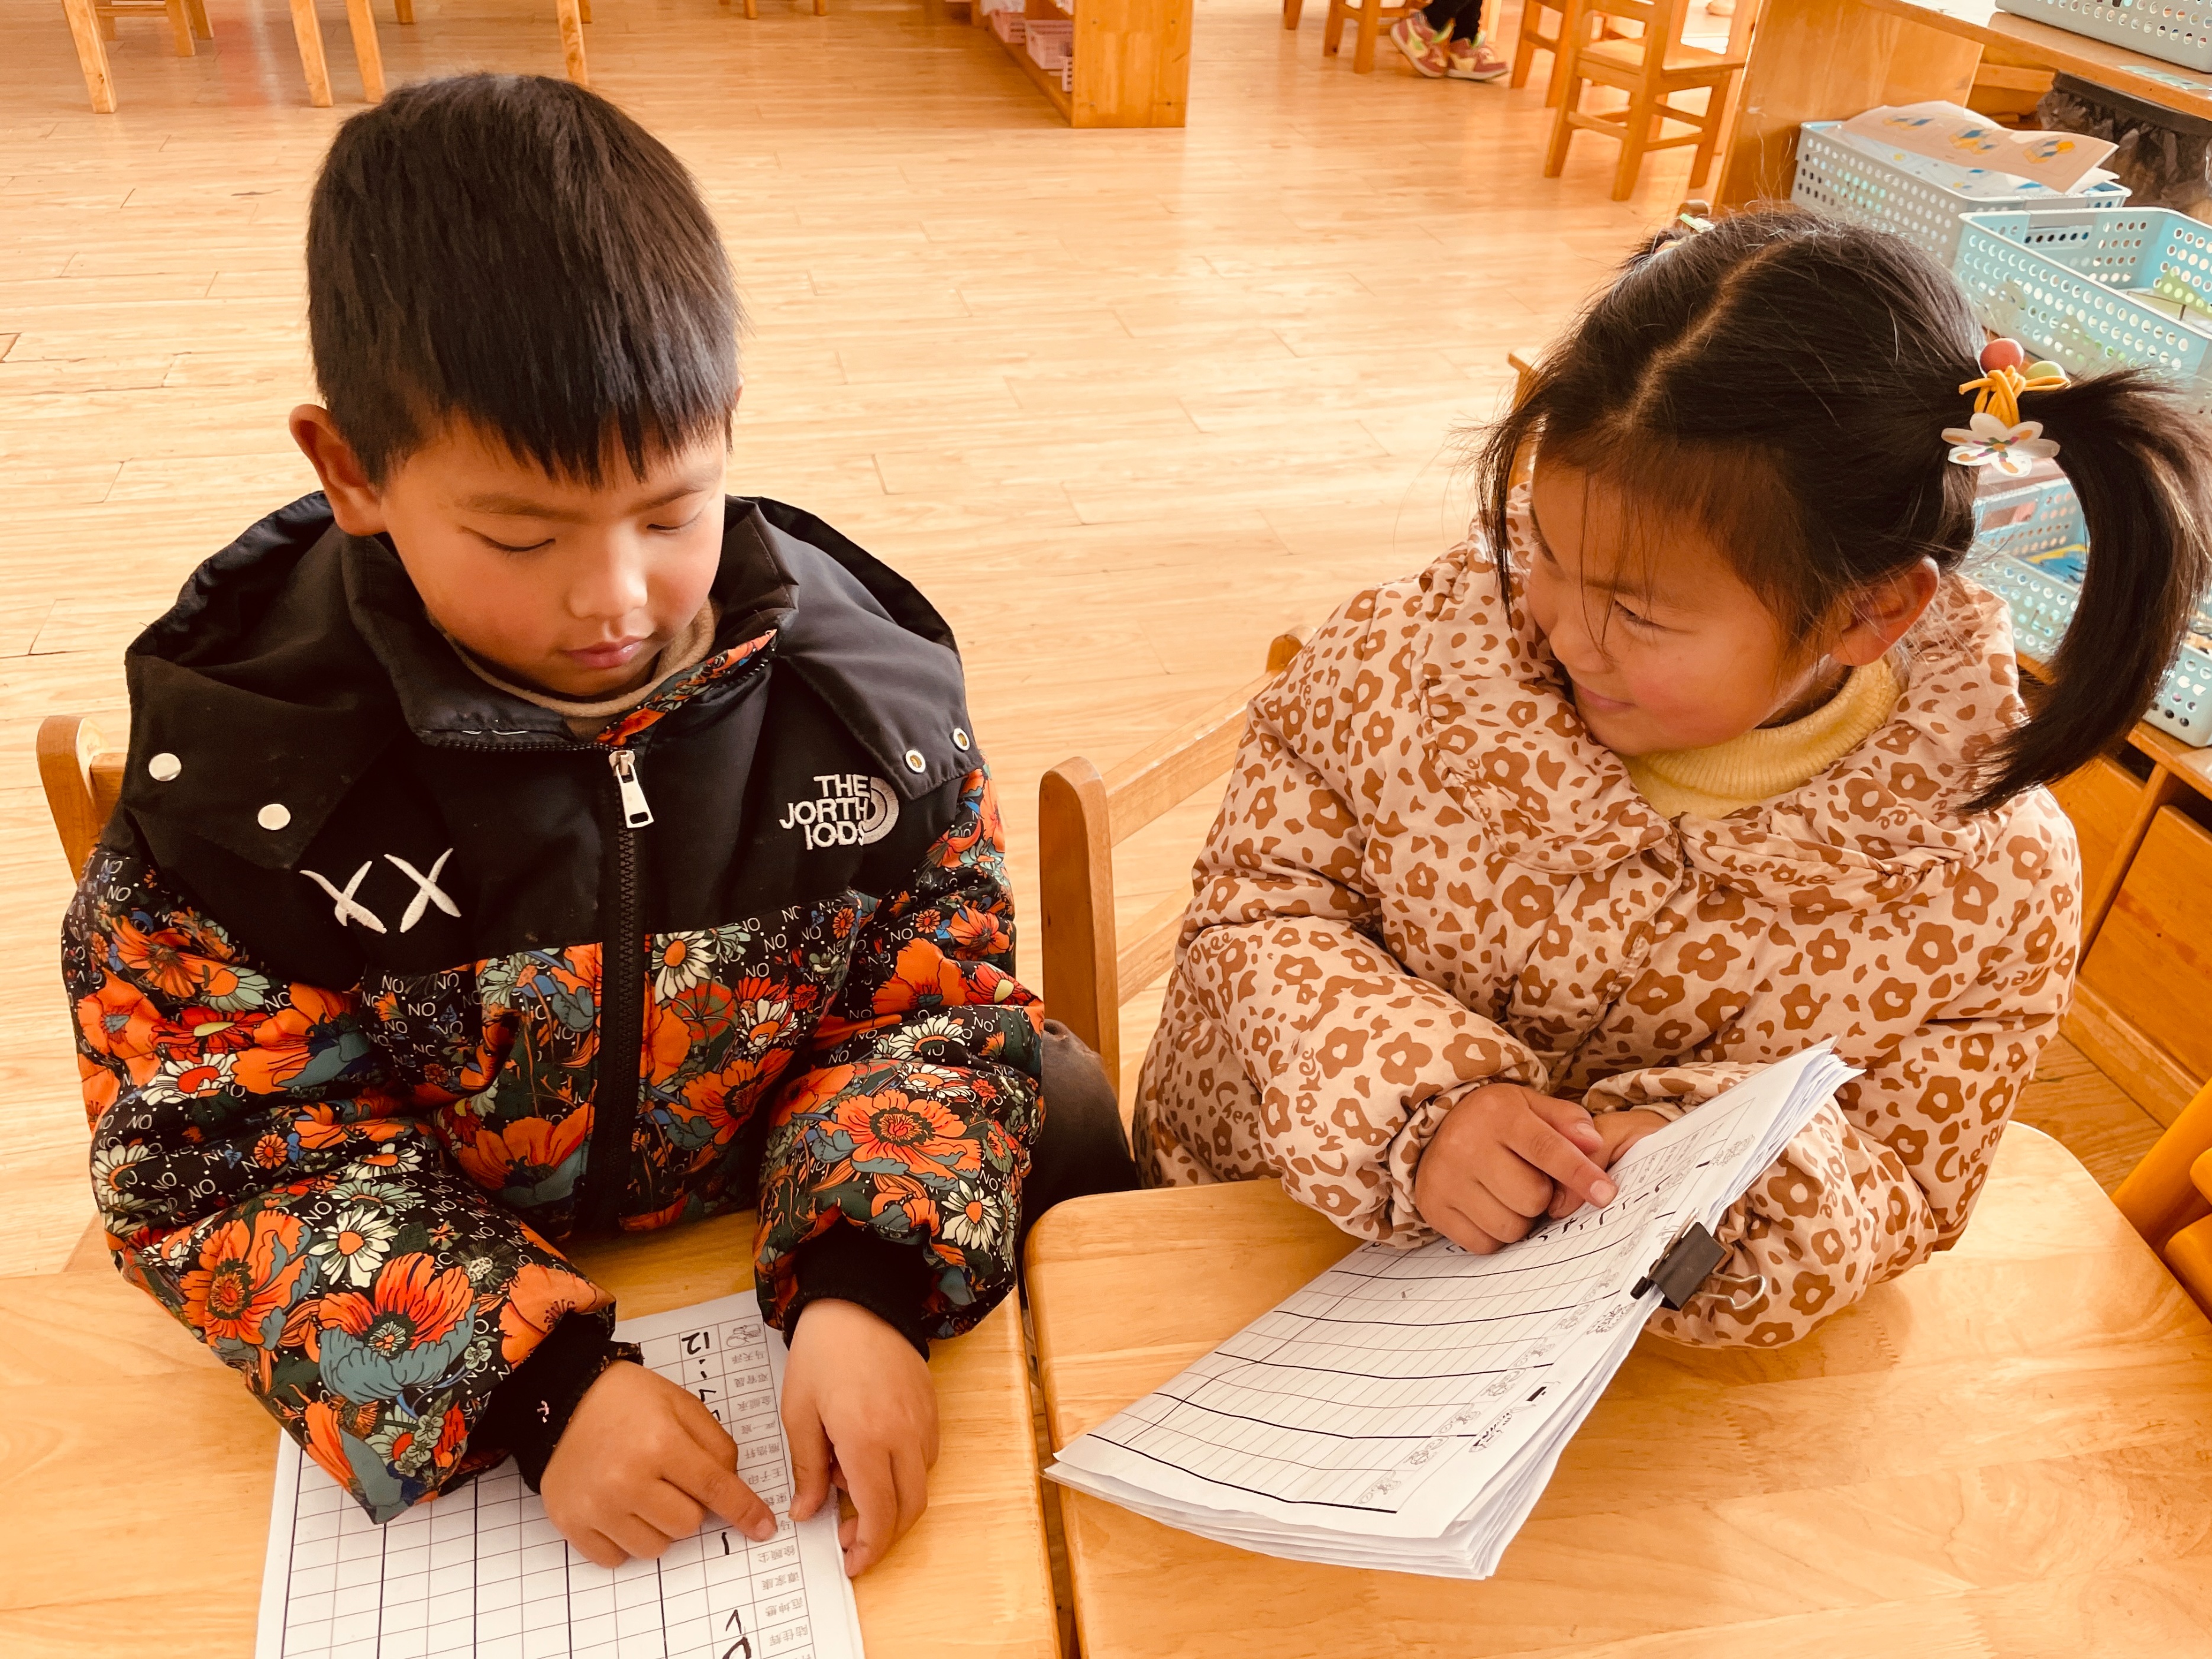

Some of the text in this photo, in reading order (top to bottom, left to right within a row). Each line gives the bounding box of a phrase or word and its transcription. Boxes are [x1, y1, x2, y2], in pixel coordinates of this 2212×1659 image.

[813, 774, 871, 798] THE
[106, 886, 131, 901] NO
[802, 925, 821, 941] NO
[890, 928, 913, 943] NO
[764, 934, 787, 953] NO
[746, 963, 769, 977] NO
[382, 976, 404, 993] NO
[409, 1002, 435, 1016] NO
[850, 1009, 871, 1019] NO
[385, 1021, 408, 1034] NO
[974, 1016, 994, 1032] NO
[367, 1032, 389, 1046] NO
[828, 1050, 849, 1064] NO
[126, 1114, 152, 1129] NO
[151, 1172, 177, 1192] NO
[979, 1170, 999, 1191] NO
[188, 1179, 215, 1202] NO
[430, 1184, 454, 1196] NO
[302, 1202, 331, 1227] NO
[431, 1200, 457, 1215] NO
[469, 1227, 495, 1241] NO
[507, 1235, 529, 1247] NO
[682, 1331, 710, 1355] 12
